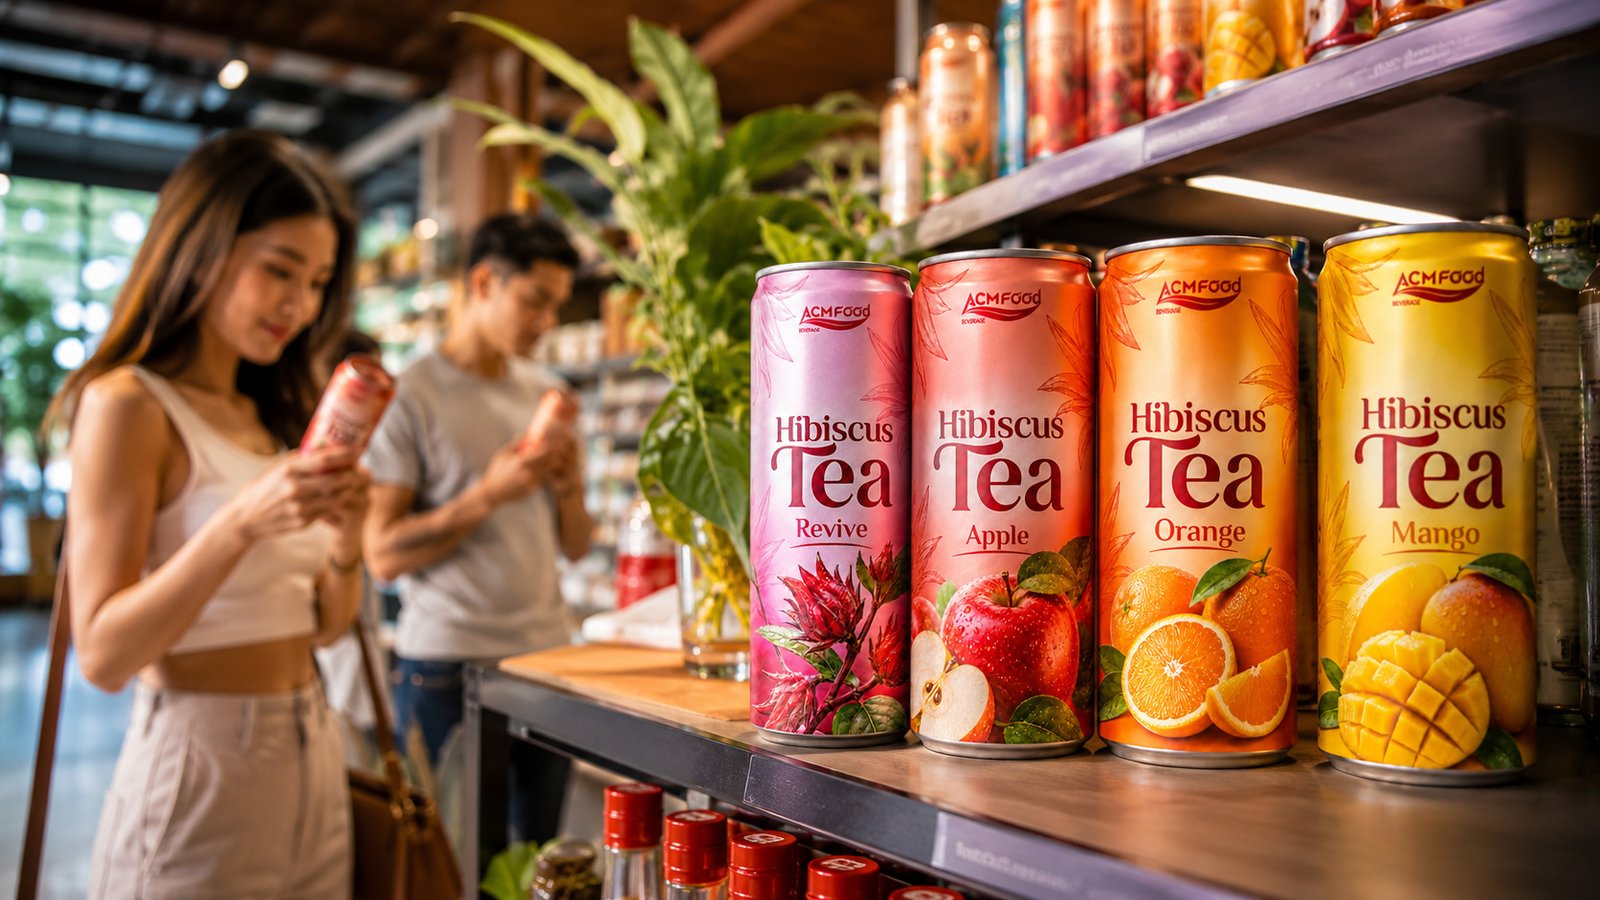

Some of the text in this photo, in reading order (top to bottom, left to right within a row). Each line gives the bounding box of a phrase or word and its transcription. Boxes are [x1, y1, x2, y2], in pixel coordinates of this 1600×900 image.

[776, 415, 893, 442] Hibiscus
[938, 409, 1064, 439] Hibiscus
[1130, 401, 1266, 433] Hibiscus
[1361, 397, 1506, 430] Hibiscus
[771, 442, 893, 508] Tea
[933, 440, 1064, 512] Tea
[1124, 434, 1265, 509] Tea
[1354, 431, 1506, 510] Tea
[796, 518, 868, 538] Revive
[965, 525, 1029, 550] Apple
[1154, 518, 1246, 548] Orange
[1392, 520, 1480, 550] Mango
